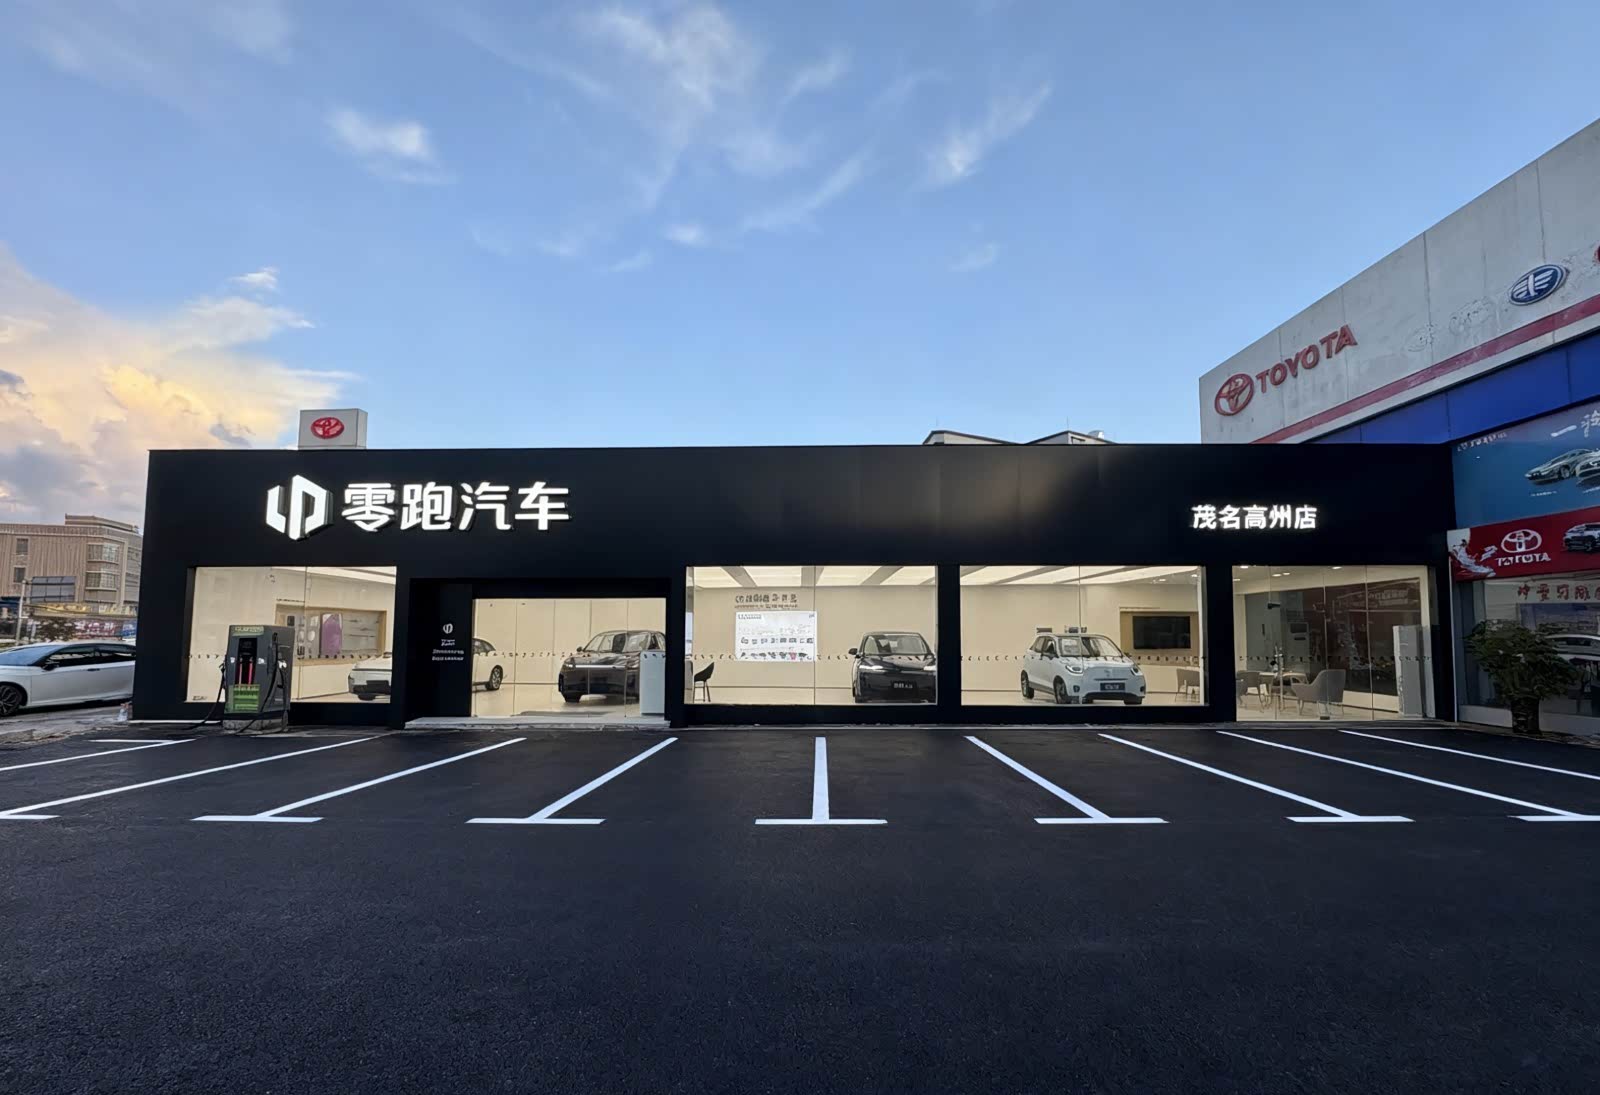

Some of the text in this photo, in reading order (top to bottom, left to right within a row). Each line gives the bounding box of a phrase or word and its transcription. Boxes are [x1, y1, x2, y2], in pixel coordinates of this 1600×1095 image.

[1255, 324, 1358, 394] TOYOTA
[341, 481, 570, 532] 零跑汽车
[1191, 504, 1318, 529] 茂名高州店
